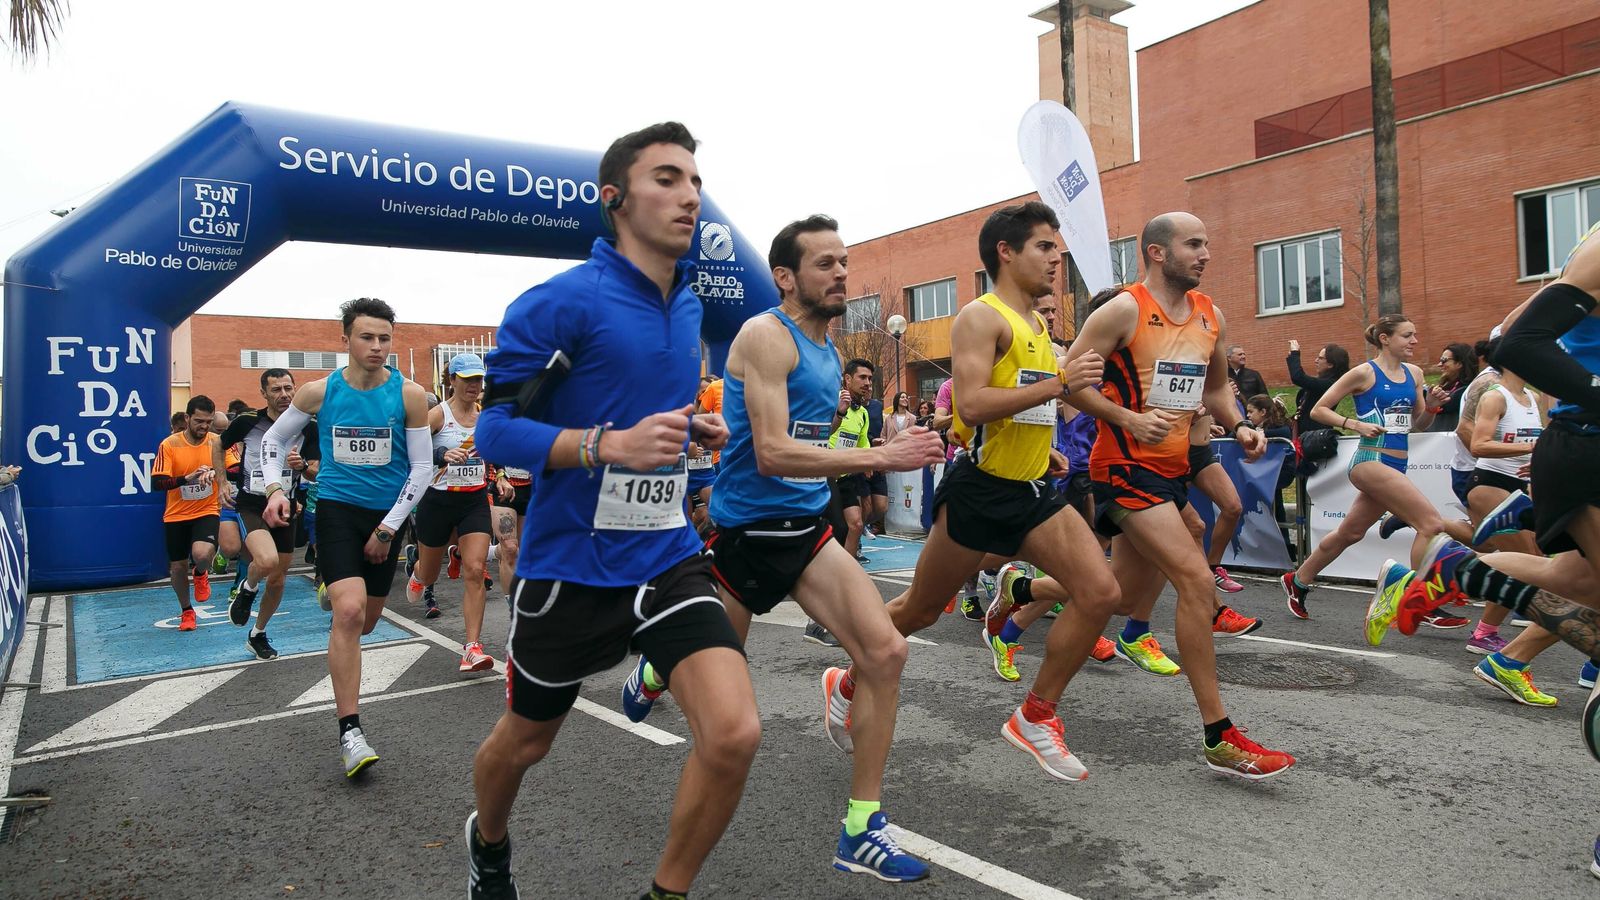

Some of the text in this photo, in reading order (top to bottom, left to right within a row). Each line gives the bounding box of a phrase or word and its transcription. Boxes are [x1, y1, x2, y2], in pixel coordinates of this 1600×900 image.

[279, 136, 600, 209] Servicio de Depo
[381, 198, 580, 230] Universidad Pablo de Olavide
[178, 241, 244, 256] Universidad
[105, 248, 238, 271] Pablo de Olavide
[697, 272, 737, 287] PABLO
[690, 282, 745, 299] OLAVIDE
[1169, 377, 1195, 394] 647
[78, 381, 147, 418] DA
[1395, 415, 1409, 425] 401
[350, 439, 376, 452] 680
[457, 467, 479, 477] 1051
[624, 478, 675, 504] 1039
[1323, 510, 1346, 518] Funda
